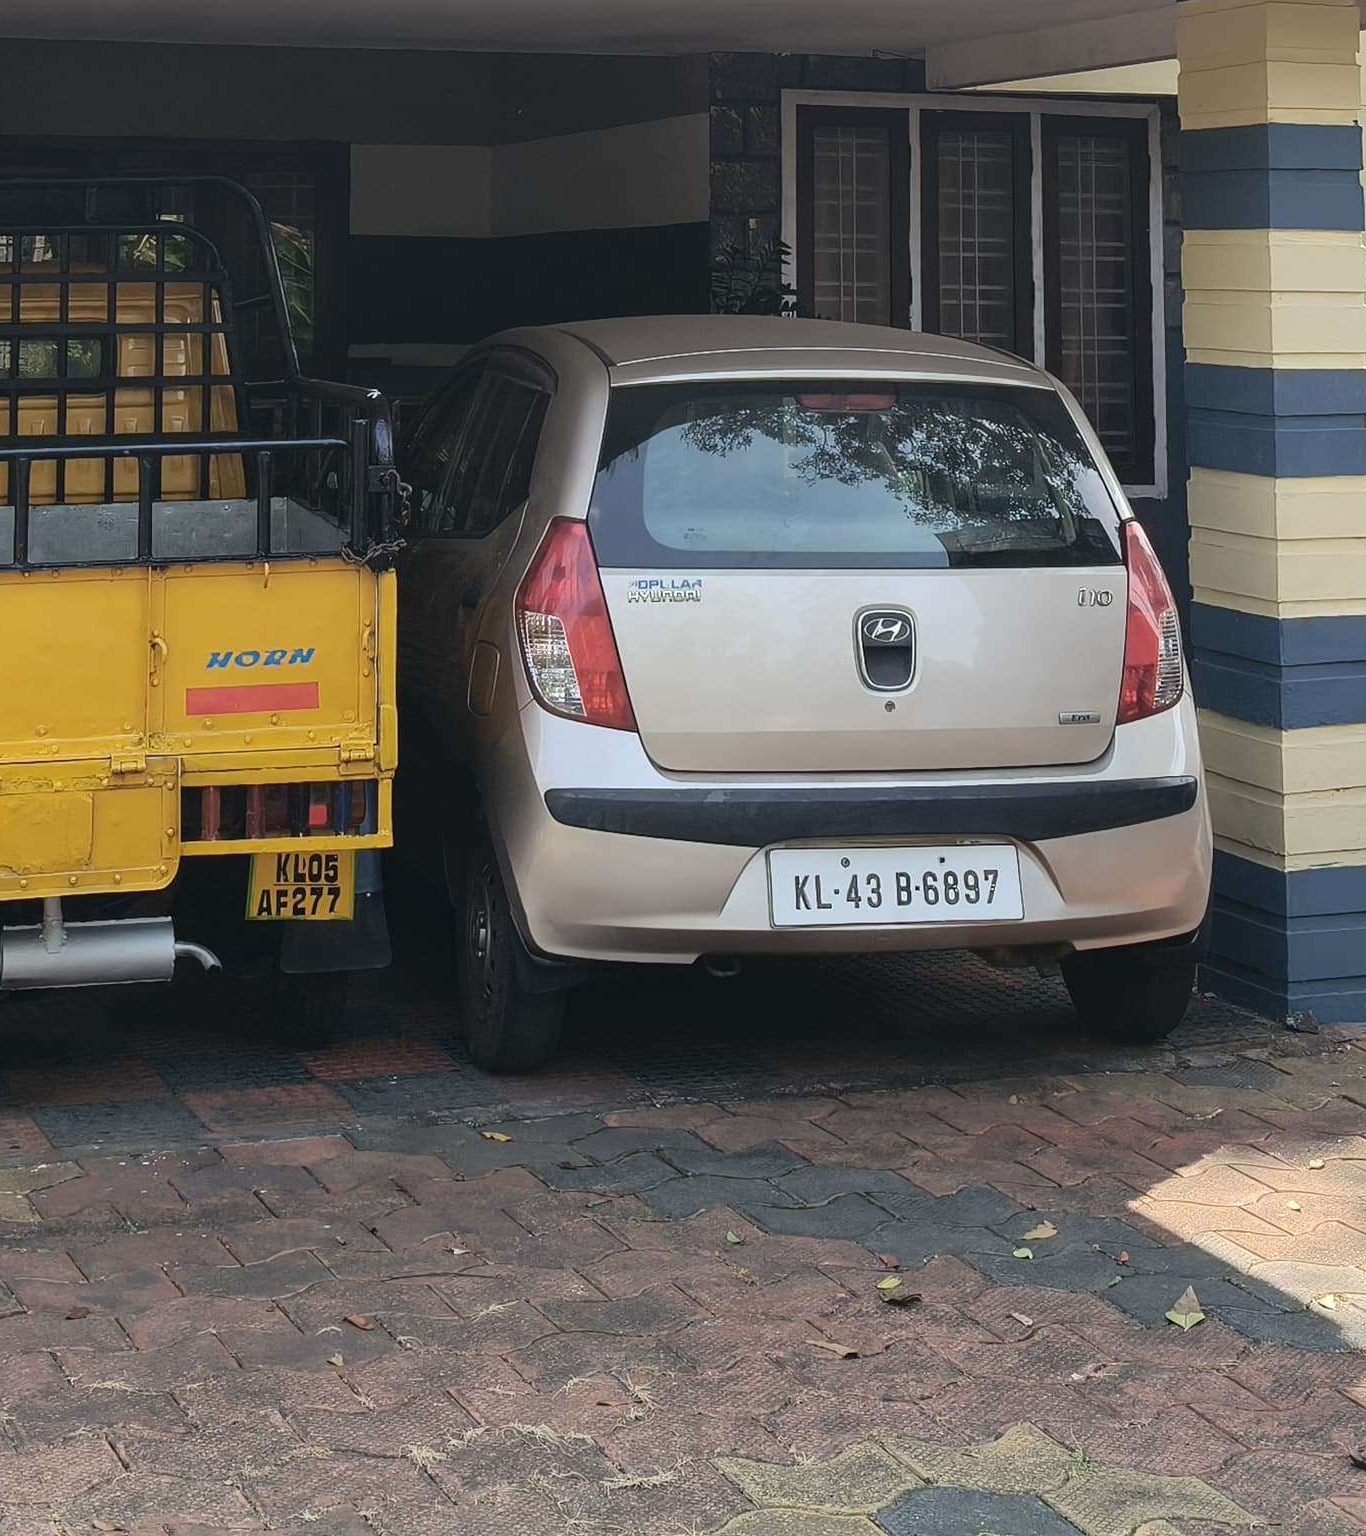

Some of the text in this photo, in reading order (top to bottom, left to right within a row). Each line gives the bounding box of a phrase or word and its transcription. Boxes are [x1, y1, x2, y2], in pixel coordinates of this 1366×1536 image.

[628, 589, 702, 603] HYUNDAI
[206, 648, 316, 669] HORN
[276, 852, 339, 884] KL05
[257, 886, 341, 917] AF277
